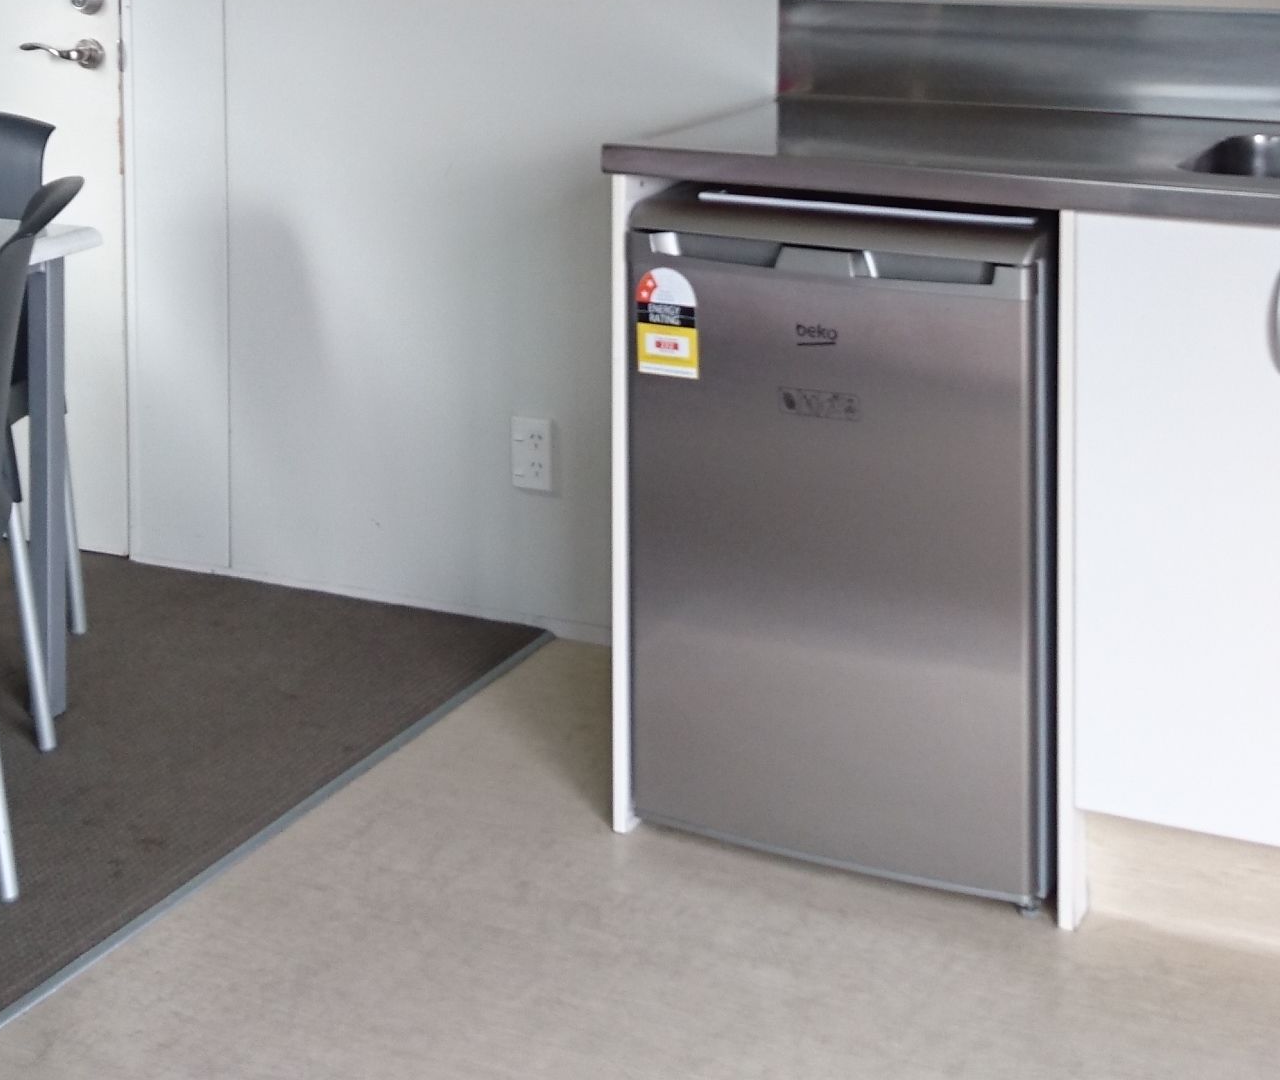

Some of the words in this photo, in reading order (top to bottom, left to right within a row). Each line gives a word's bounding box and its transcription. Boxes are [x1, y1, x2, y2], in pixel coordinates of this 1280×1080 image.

[648, 303, 680, 315] ENERGY
[648, 313, 681, 326] RATING
[796, 323, 838, 340] beko
